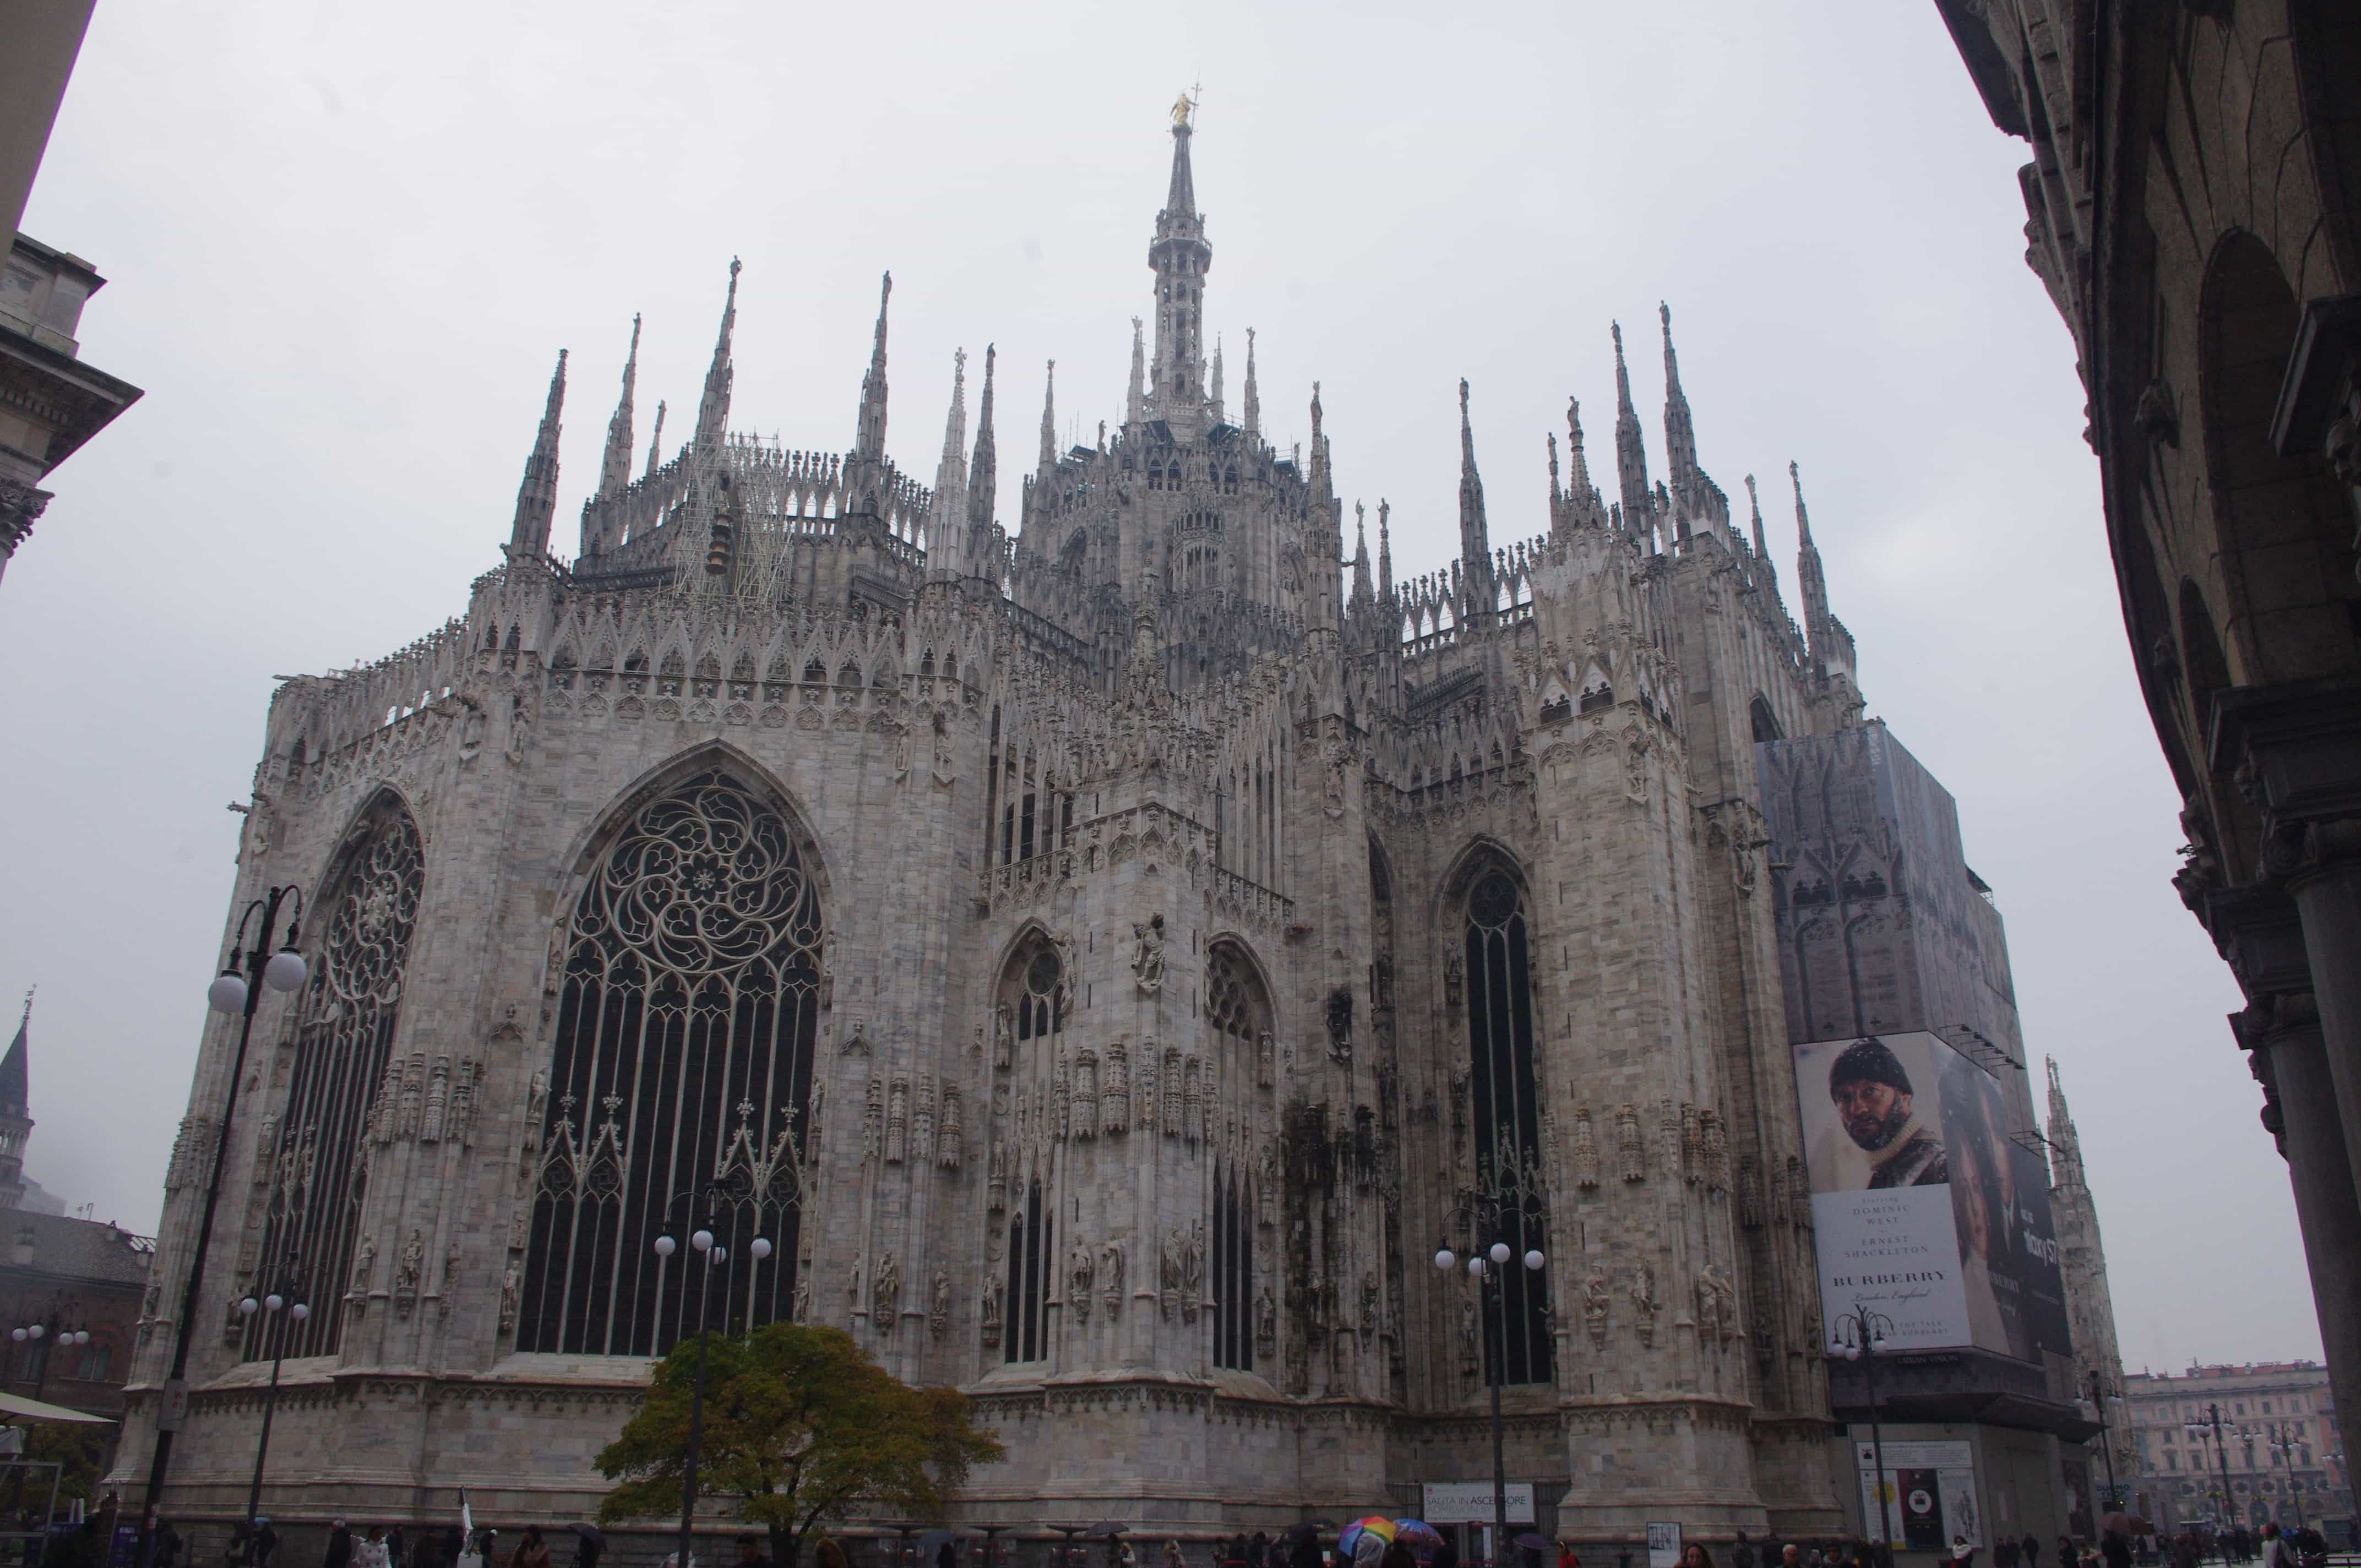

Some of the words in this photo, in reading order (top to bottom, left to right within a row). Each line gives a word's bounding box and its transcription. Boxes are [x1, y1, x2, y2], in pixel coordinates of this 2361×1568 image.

[1853, 1205, 1908, 1215] DOMINIC
[1865, 1216, 1898, 1224] WEST
[1861, 1236, 1907, 1245] ERNEST
[1845, 1246, 1928, 1258] SHACKLETON
[1834, 1271, 1944, 1287] BURBERRY
[1471, 1496, 1526, 1505] ASCEORE
